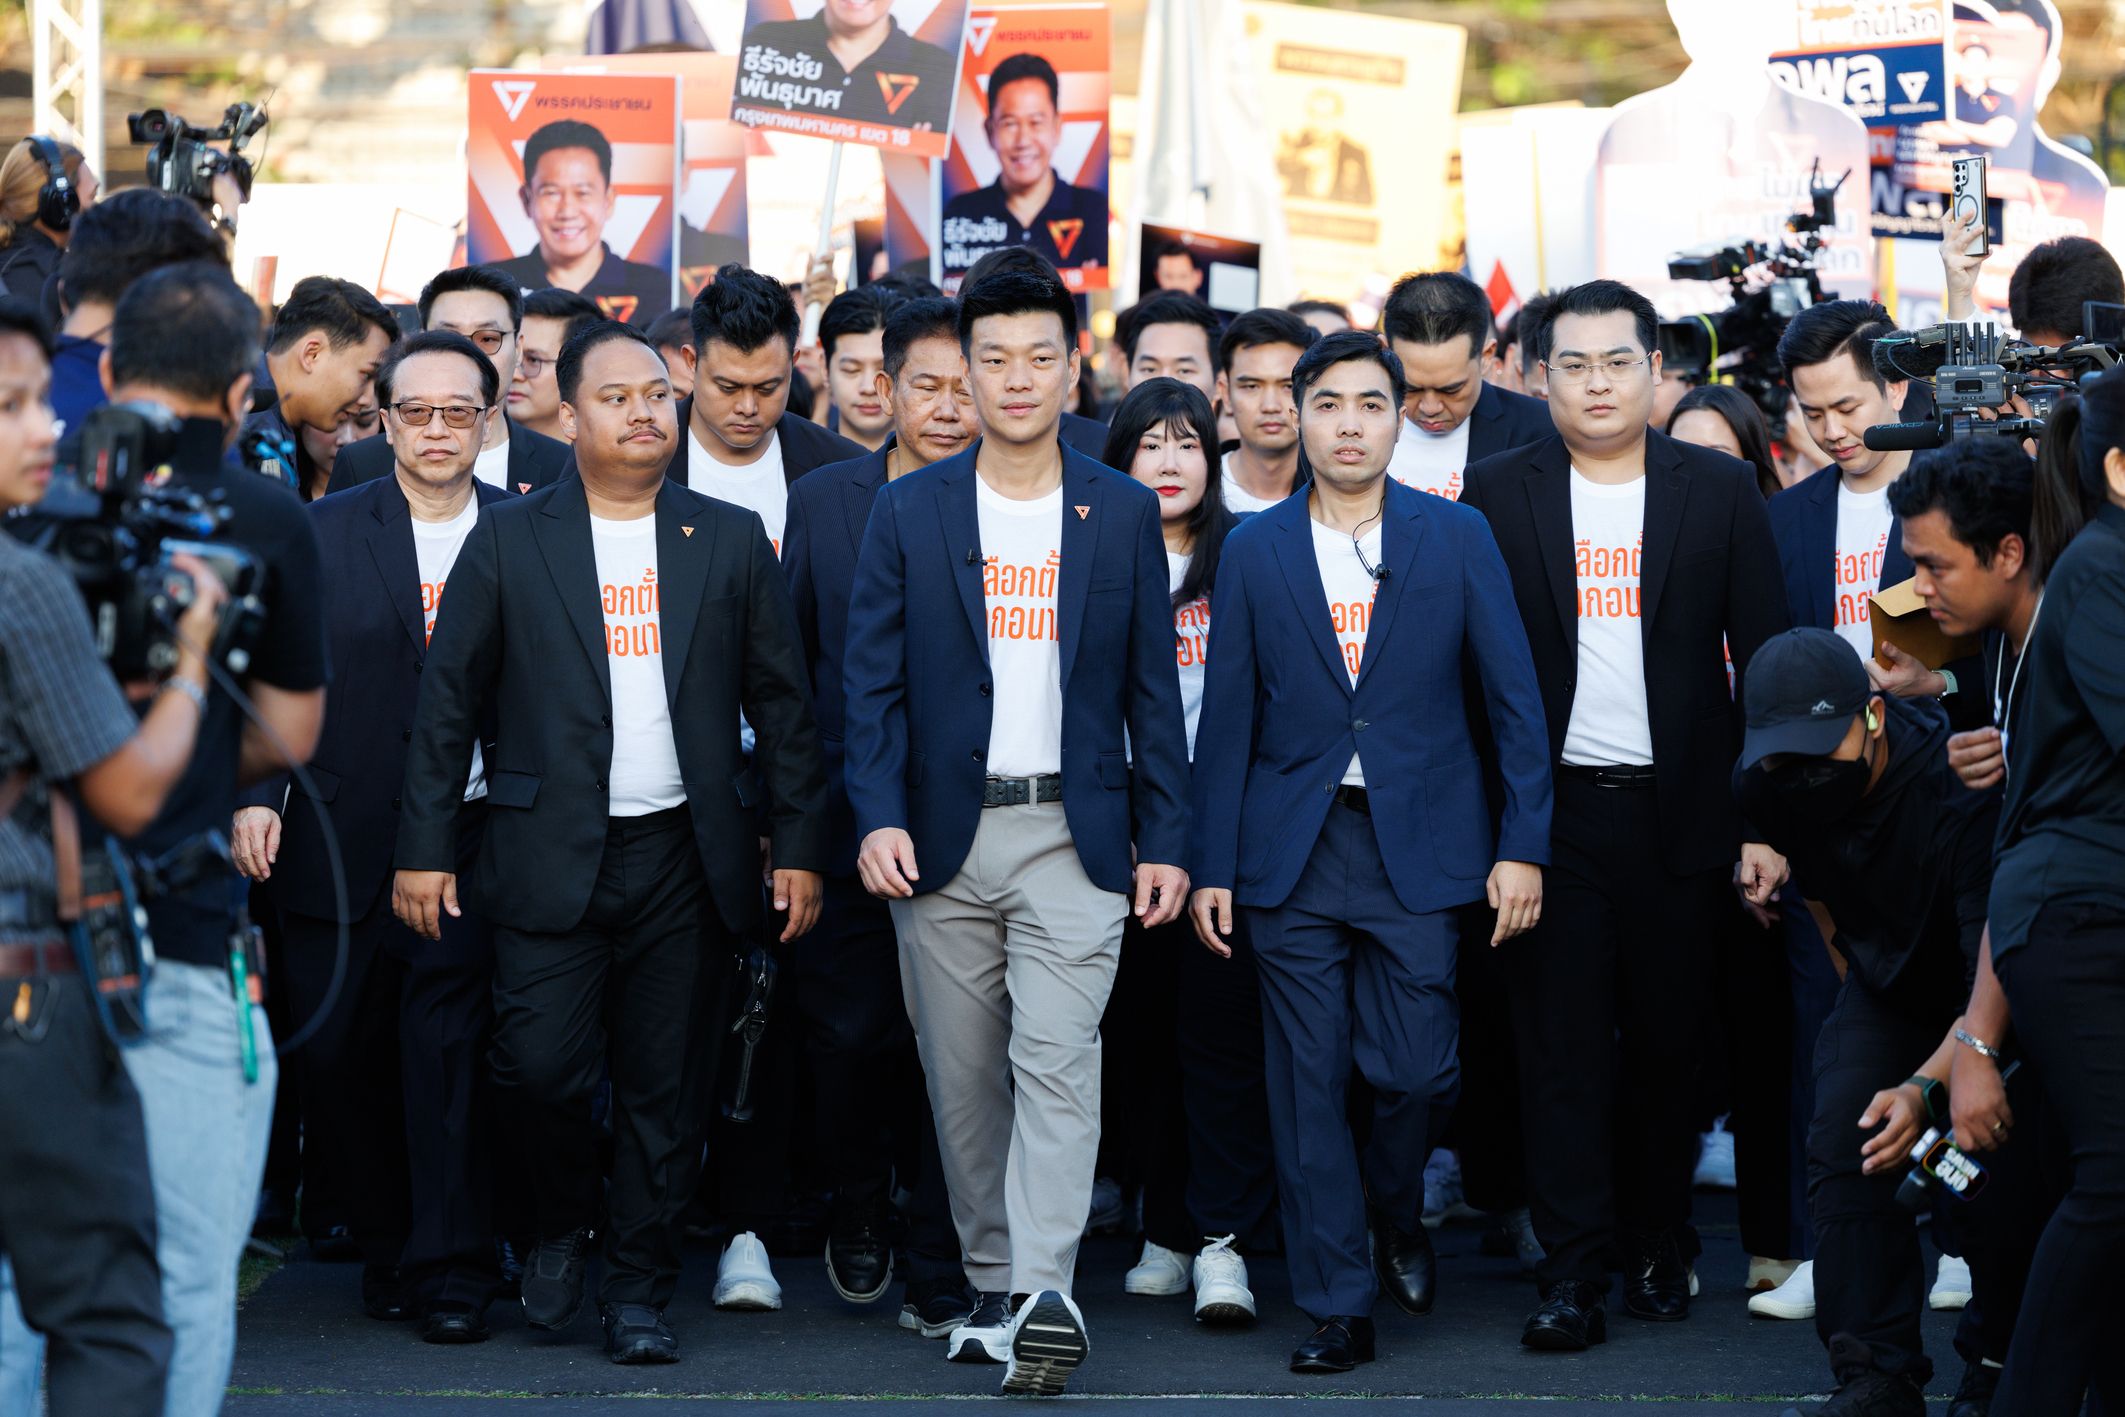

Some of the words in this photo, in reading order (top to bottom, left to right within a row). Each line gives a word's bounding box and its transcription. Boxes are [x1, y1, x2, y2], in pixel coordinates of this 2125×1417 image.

[743, 45, 823, 81] ธีรัจชัย
[891, 130, 911, 146] 18
[985, 605, 1059, 641] กอนา
